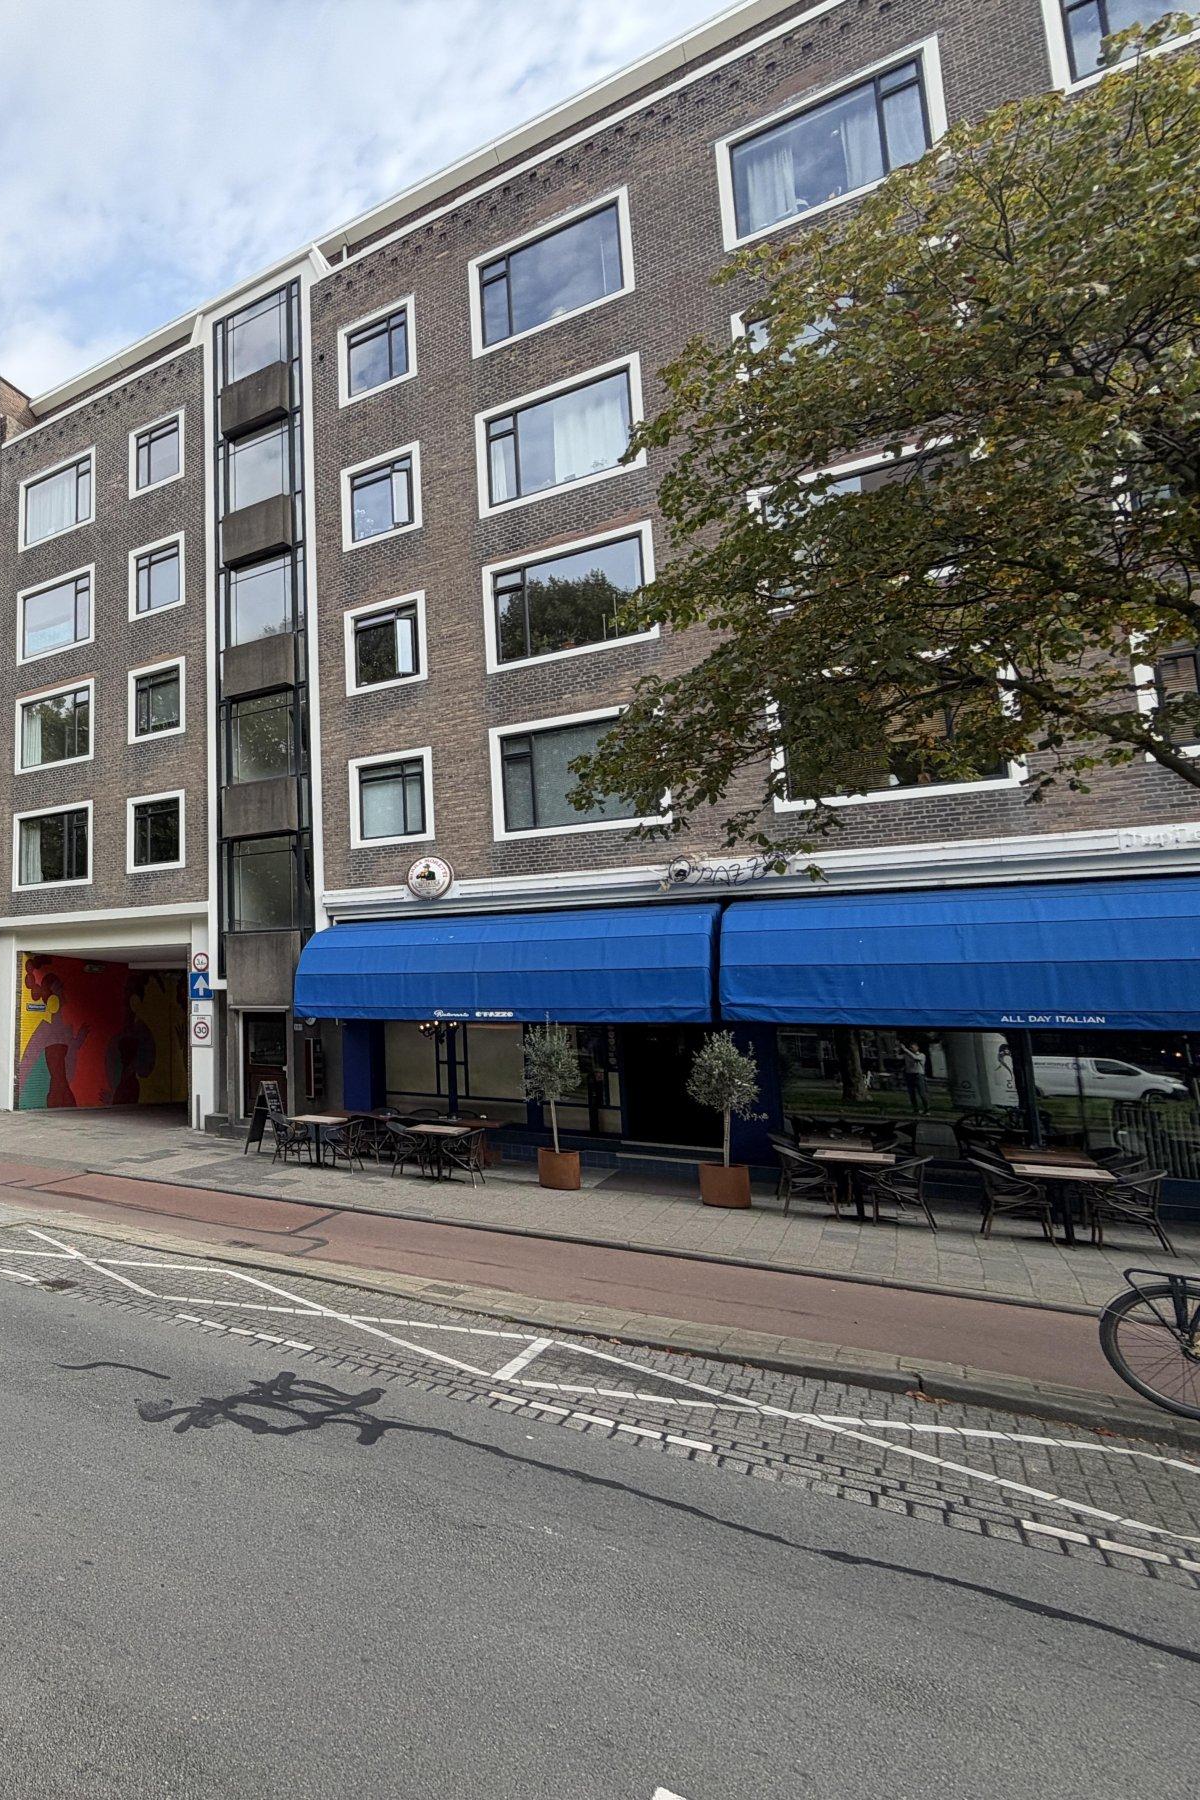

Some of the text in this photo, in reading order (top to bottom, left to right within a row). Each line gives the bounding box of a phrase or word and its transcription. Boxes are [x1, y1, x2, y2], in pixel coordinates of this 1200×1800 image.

[1000, 1015, 1106, 1024] ALL DAY ITALIAN
[196, 1026, 207, 1035] 30
